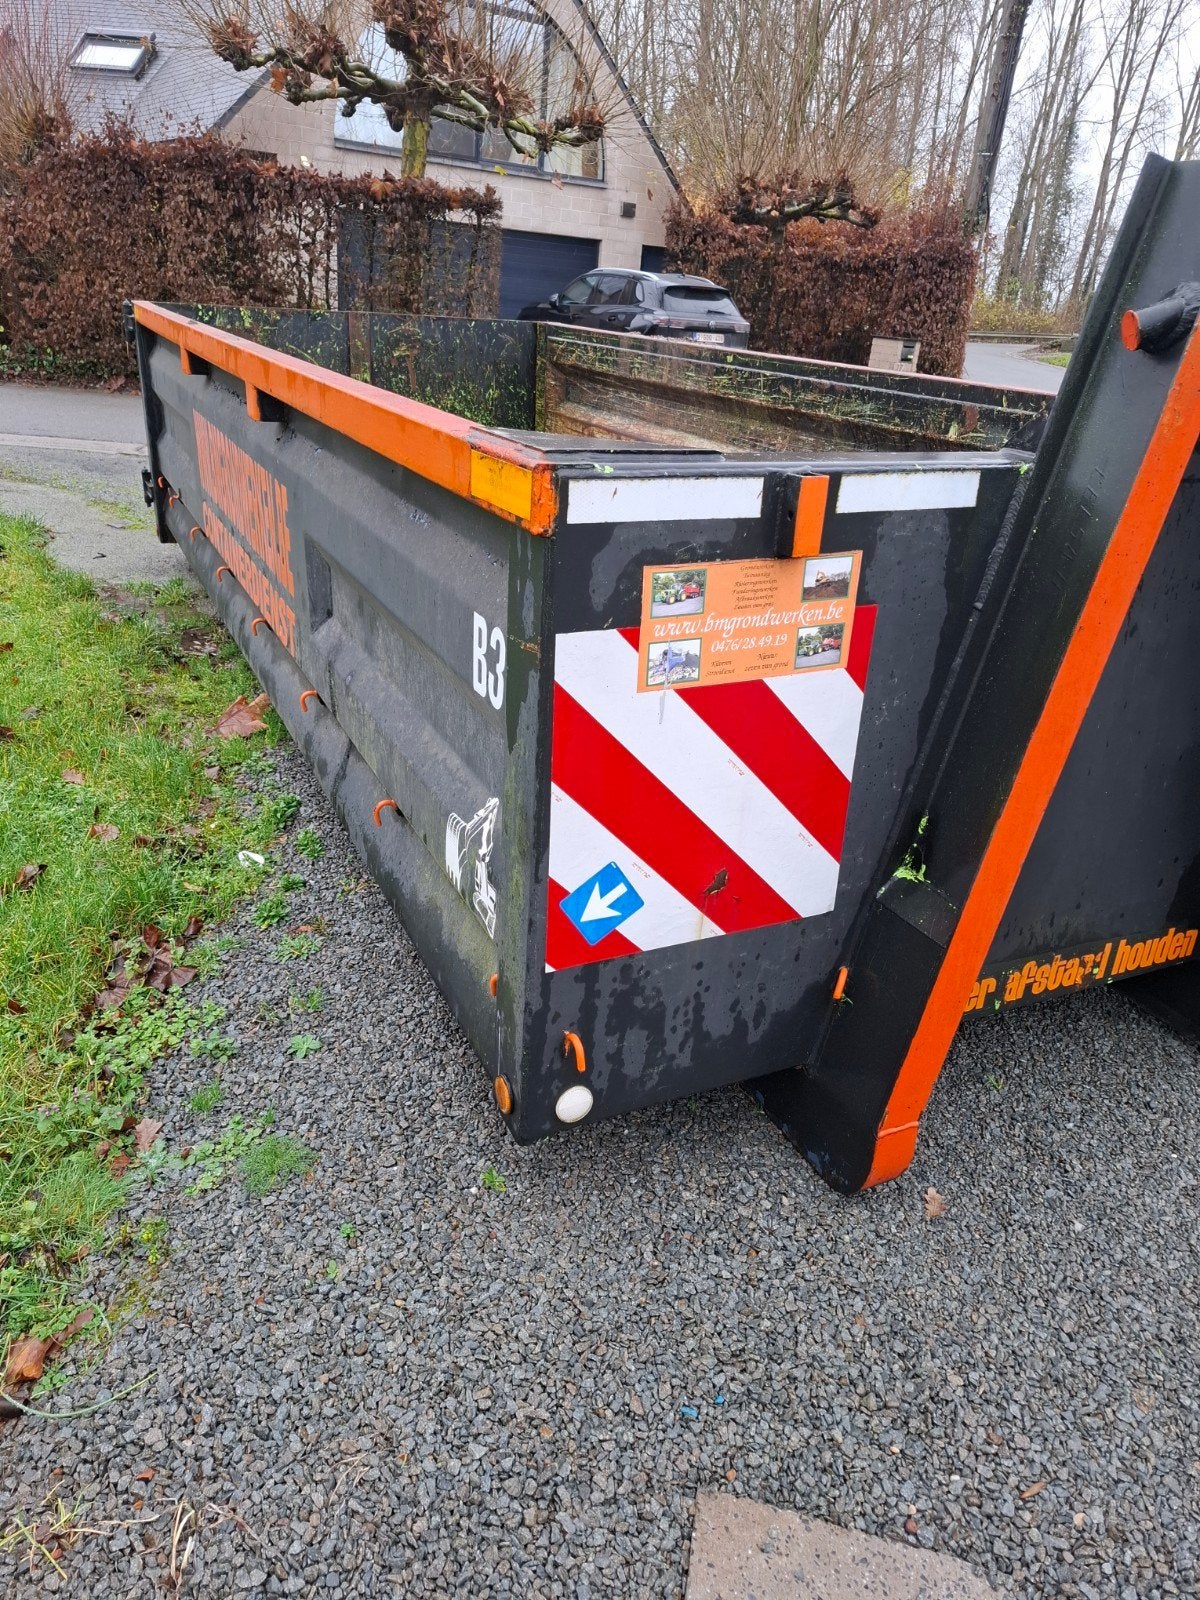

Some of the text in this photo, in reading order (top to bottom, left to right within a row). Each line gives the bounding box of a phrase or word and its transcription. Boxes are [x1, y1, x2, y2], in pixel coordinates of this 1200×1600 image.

[472, 610, 507, 711] B3
[653, 601, 844, 639] www.bmgrondwerken.be
[963, 977, 997, 1013] er
[1111, 927, 1199, 976] houden
